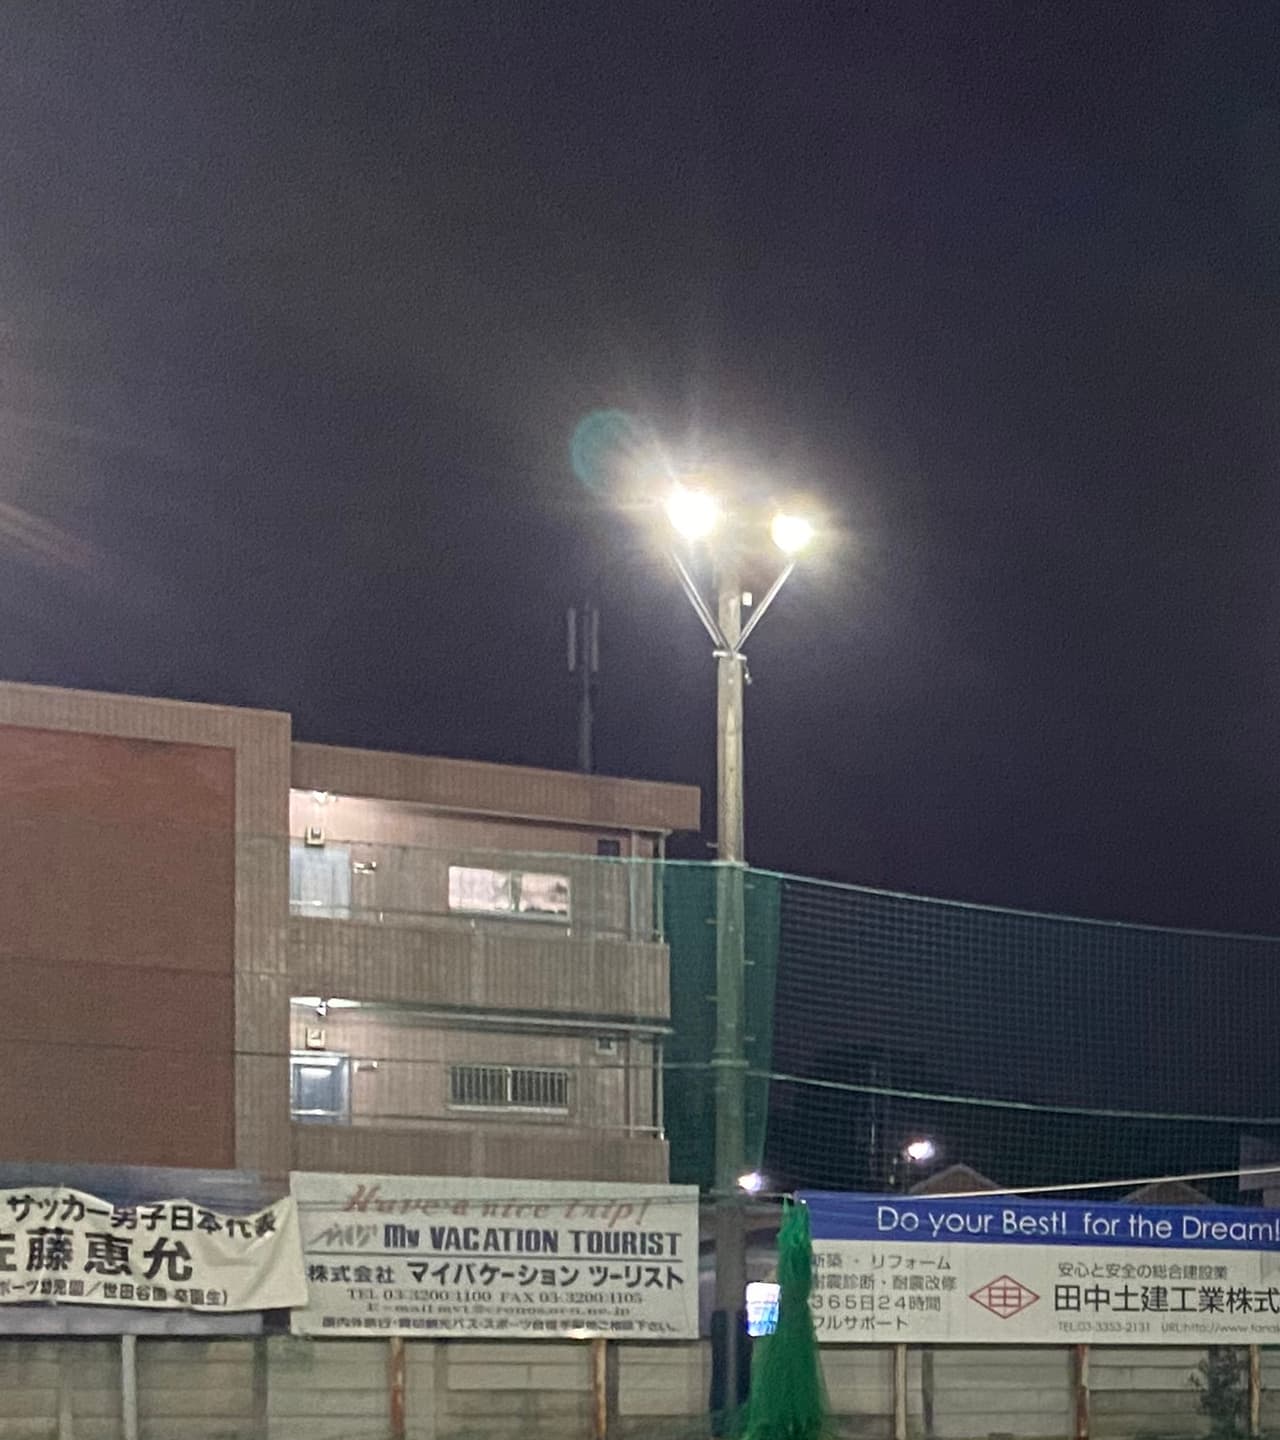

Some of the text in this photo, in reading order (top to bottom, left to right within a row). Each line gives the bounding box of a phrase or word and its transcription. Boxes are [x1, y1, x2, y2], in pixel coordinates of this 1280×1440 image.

[877, 1206, 1280, 1242] Do your Best! for the Dream!
[430, 1226, 559, 1254] VACATION
[568, 1230, 682, 1256] TOURIST
[308, 1261, 684, 1290] 株式会社 マイバケーション ツーリスト
